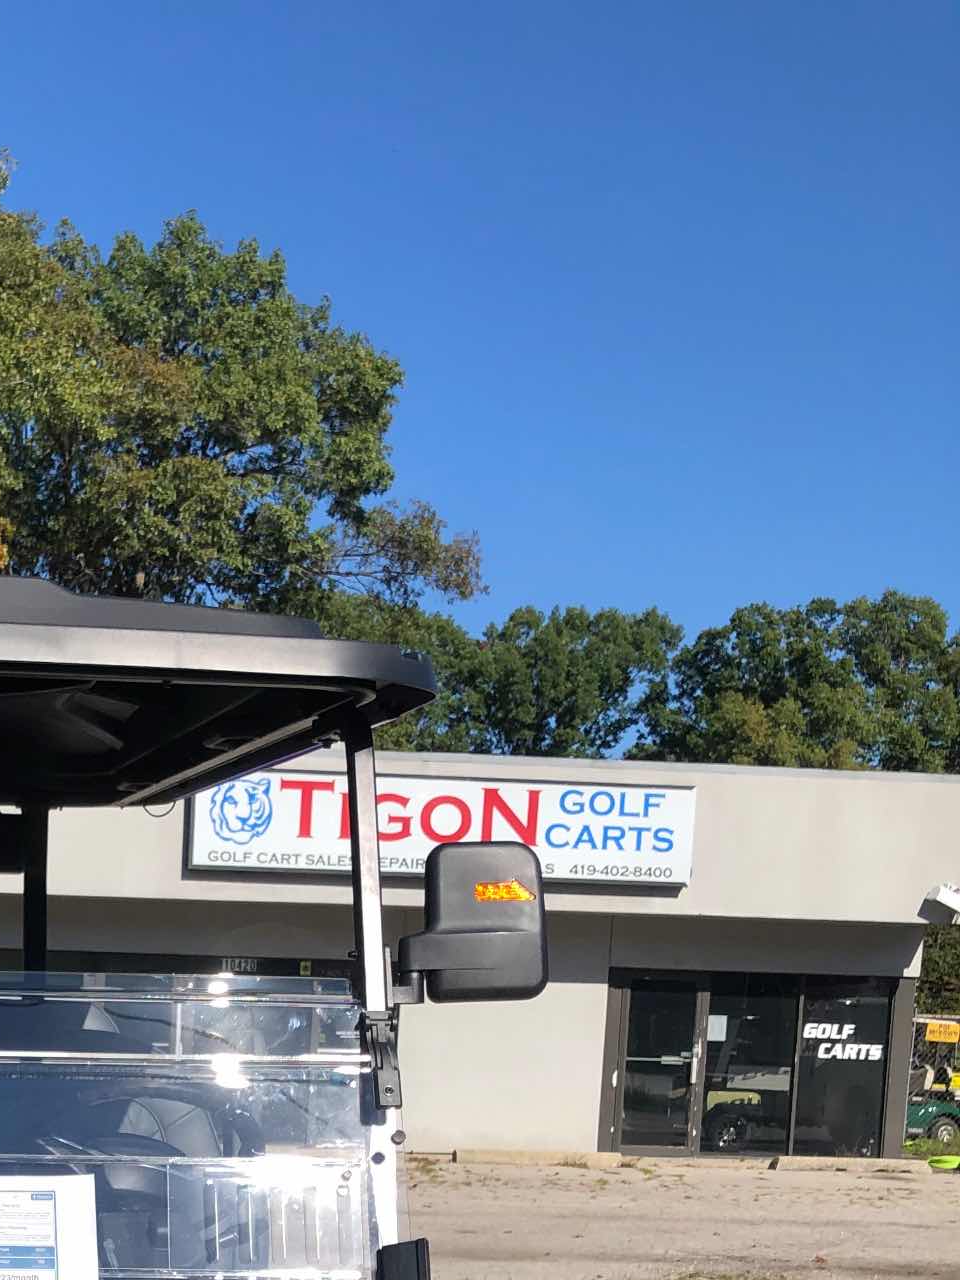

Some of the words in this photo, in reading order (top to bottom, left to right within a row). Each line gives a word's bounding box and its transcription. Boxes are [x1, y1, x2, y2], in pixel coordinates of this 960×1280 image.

[280, 777, 542, 847] TIGON
[560, 789, 666, 818] GOLF
[545, 823, 674, 853] CARTS
[207, 850, 253, 864] GOLF
[256, 851, 301, 866] CART
[379, 856, 426, 870] EPAIR
[569, 863, 673, 879] 419-402-8400
[803, 1022, 856, 1040] GOLF
[817, 1042, 883, 1060] CARTS
